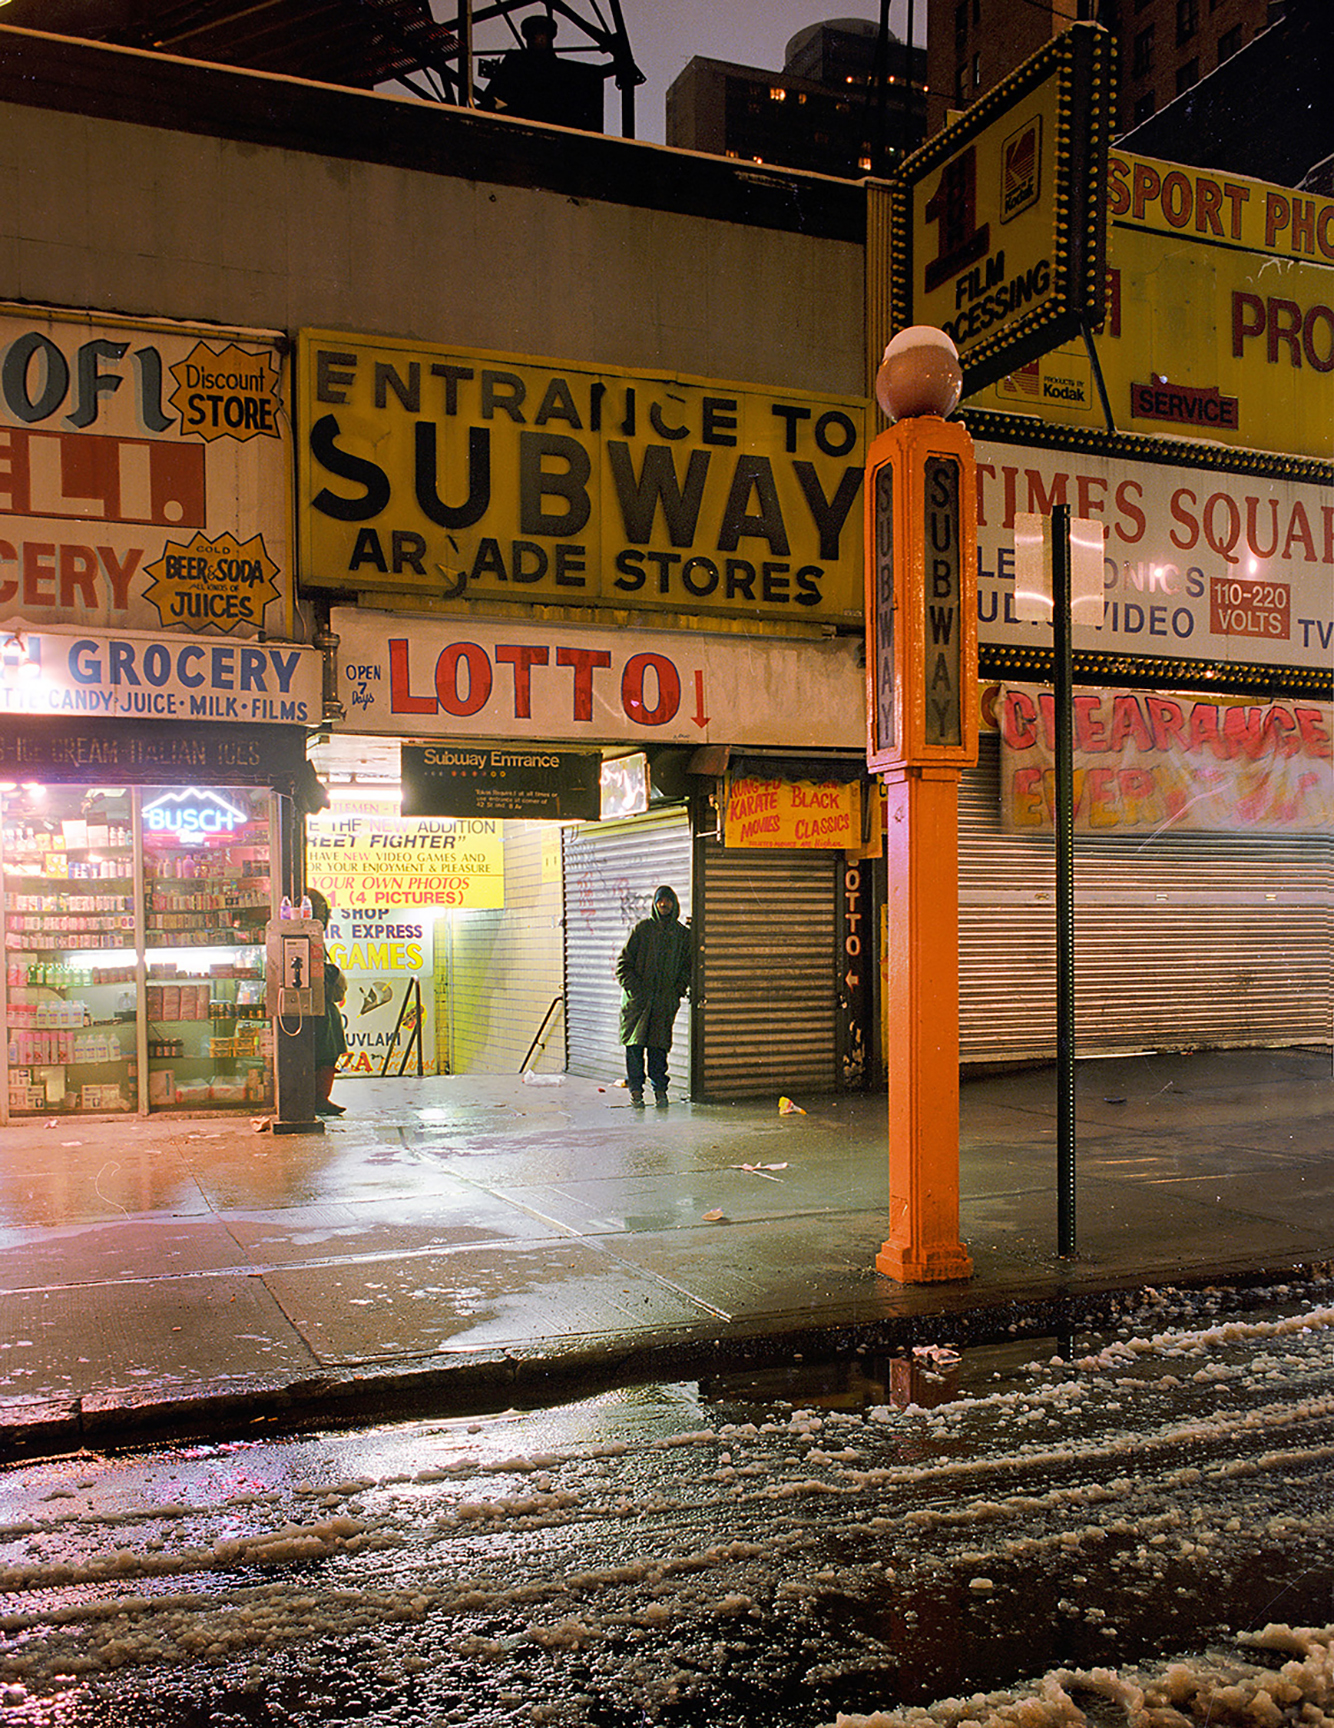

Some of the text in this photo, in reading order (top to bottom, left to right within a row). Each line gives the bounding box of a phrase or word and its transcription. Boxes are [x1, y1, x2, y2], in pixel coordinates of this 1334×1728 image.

[1004, 182, 1035, 215] Kodak
[1107, 157, 1250, 241] SPORT
[925, 144, 990, 294] 1
[955, 250, 1005, 310] FILM
[1232, 290, 1334, 373] PRO
[186, 364, 265, 392] Discount
[1044, 375, 1075, 387] PRODUCTS
[1043, 383, 1085, 402] Kodak
[187, 393, 274, 431] STORE
[1138, 388, 1234, 425] SERVICE
[772, 403, 857, 458] TO
[0, 432, 184, 522] LI.
[310, 413, 866, 561] SUBWAY
[196, 545, 231, 554] COLD
[189, 583, 205, 591] ALL
[229, 584, 240, 592] OF
[615, 549, 826, 607] STORES
[170, 591, 254, 618] JUICES
[878, 473, 894, 741] SUBWAY
[929, 468, 954, 738] SUBWAY
[1214, 583, 1287, 609] 110-220
[1218, 608, 1282, 635] VOLTS
[1297, 618, 1334, 650] TV
[68, 639, 302, 694] GROCERY
[346, 664, 381, 681] OPEN
[357, 681, 367, 695] 7
[388, 638, 681, 727] LOTTO
[48, 688, 114, 711] CANDY
[119, 691, 177, 715] JUICE
[190, 695, 239, 718] MILK
[252, 698, 308, 722] FILMS
[351, 690, 375, 711] Days
[52, 736, 118, 763] CREAM
[424, 749, 560, 770] Subway Entrance
[729, 791, 778, 822] KARATE
[790, 785, 840, 809] BLACK
[149, 807, 234, 831] BUSCH
[330, 817, 362, 832] THE
[369, 819, 409, 833] NEW
[417, 819, 496, 834] ADDITION
[740, 814, 781, 842] MOVIES
[794, 813, 850, 840] CLASSICS
[310, 851, 486, 863] HAVE NEW VIDEO GAMES AND
[327, 862, 358, 872] YOUR
[362, 863, 425, 873] ENJOYMENT
[428, 863, 437, 873] &
[441, 863, 491, 874] PLEASURE
[312, 876, 471, 890] YOUR OWN PHOTOS
[341, 908, 389, 920] SHOP
[352, 924, 423, 939] EXPRESS
[329, 942, 424, 971] GAMES
